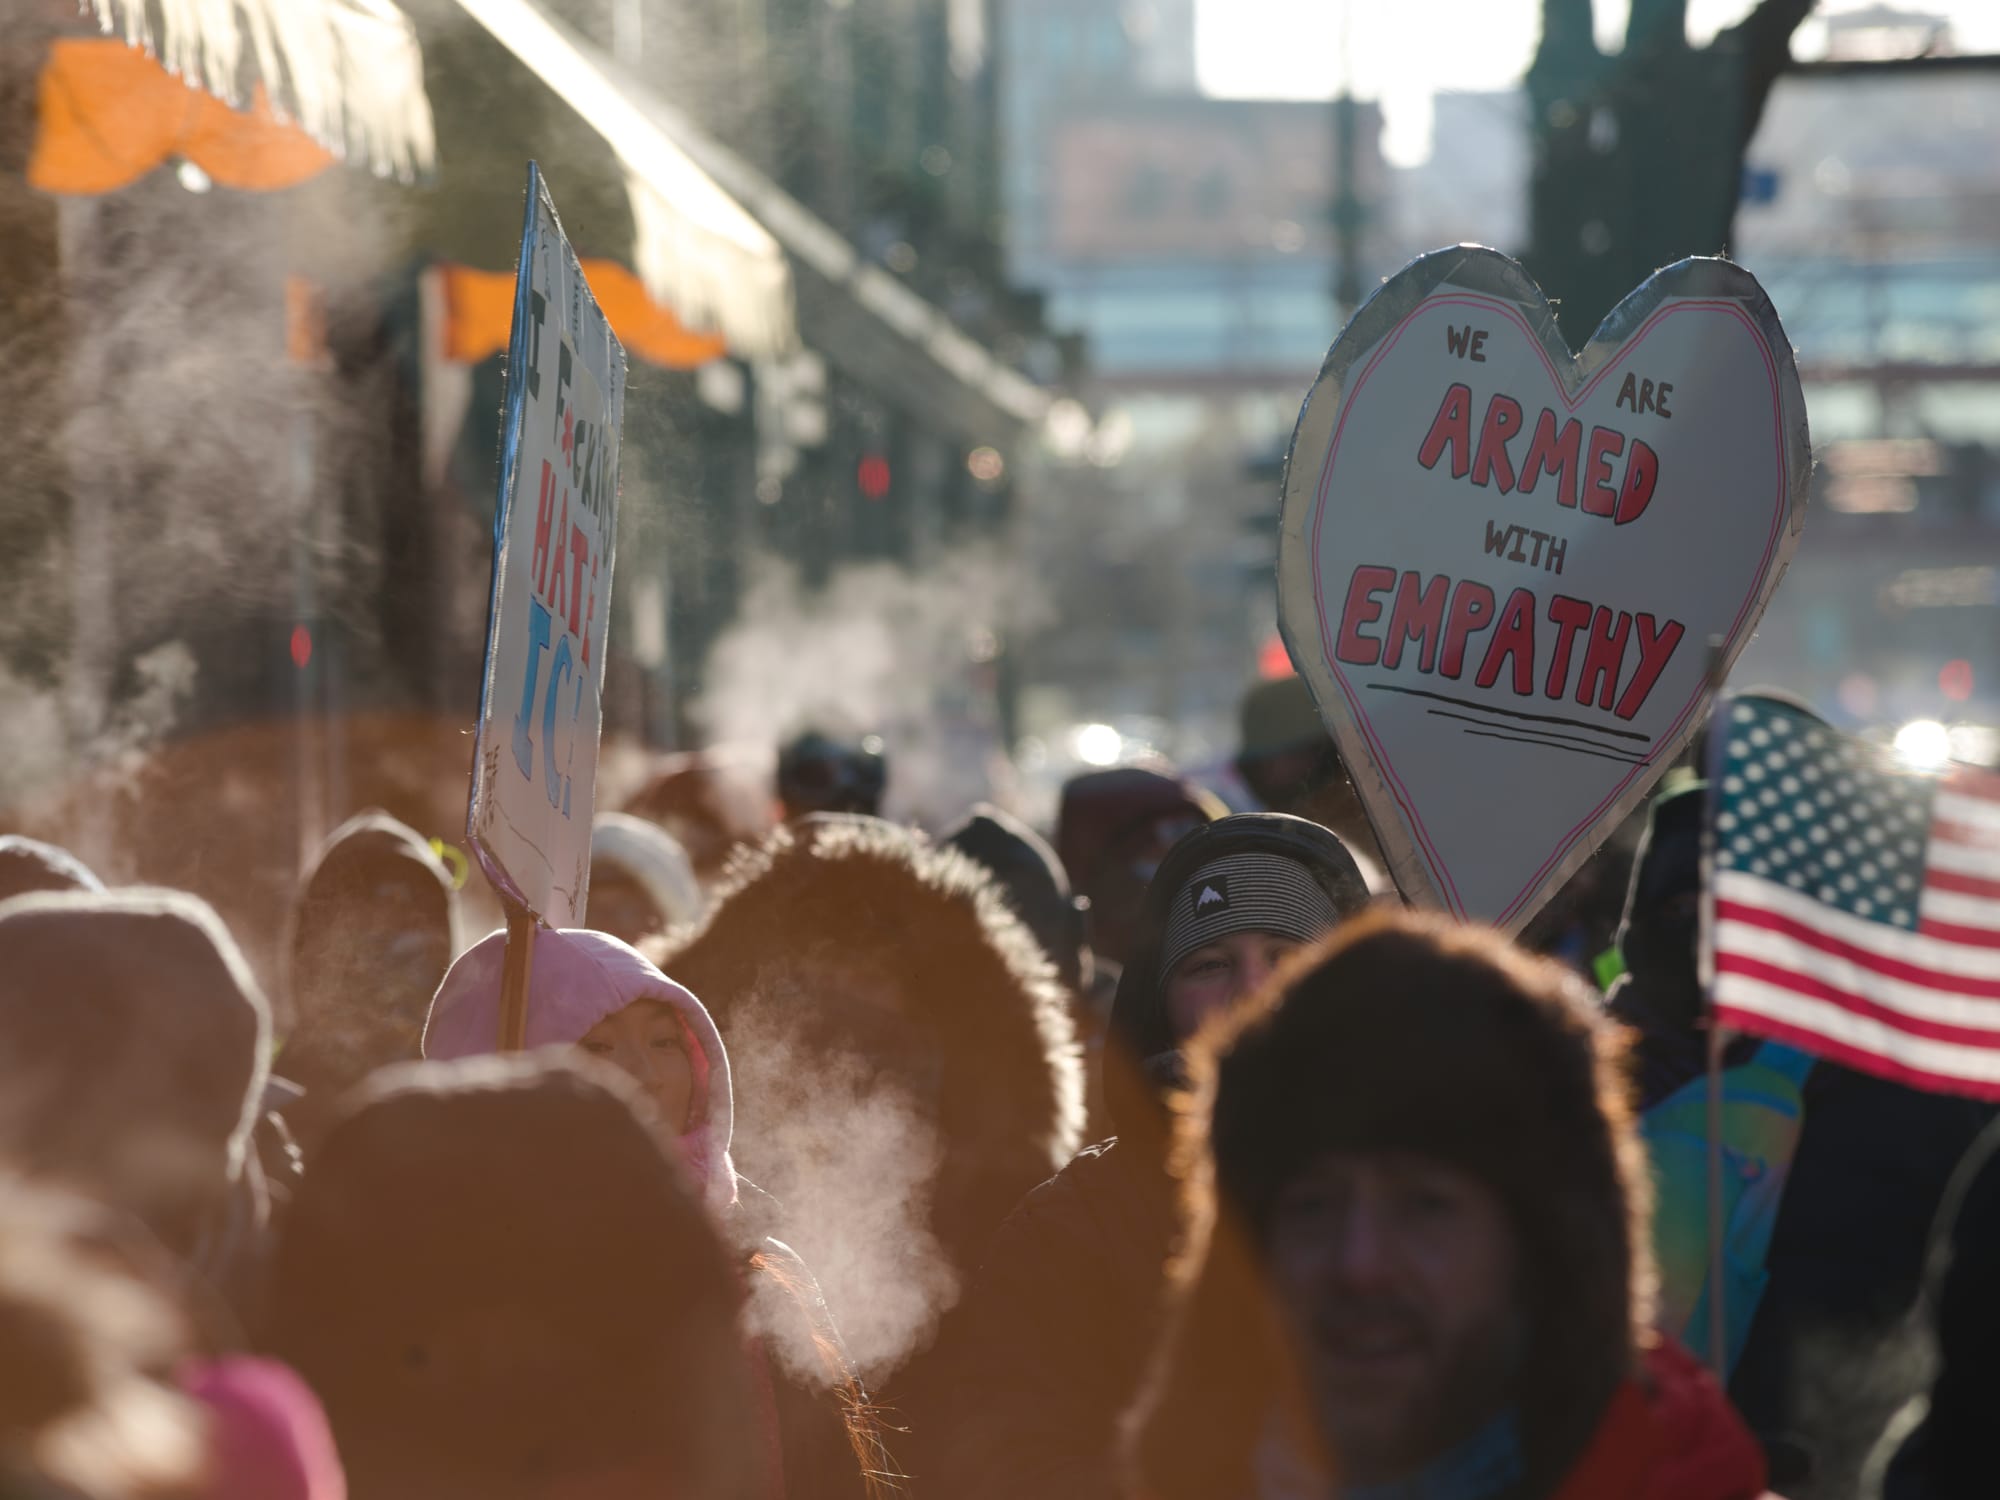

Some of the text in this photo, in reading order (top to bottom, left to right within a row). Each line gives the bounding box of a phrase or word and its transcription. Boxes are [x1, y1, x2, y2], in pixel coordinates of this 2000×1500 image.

[528, 287, 546, 402] I
[1446, 325, 1674, 419] WE ARE
[1418, 382, 1660, 526] ARMED
[531, 457, 599, 673] HATE
[1484, 519, 1568, 575] WITH
[1336, 564, 1686, 721] EMPATHY
